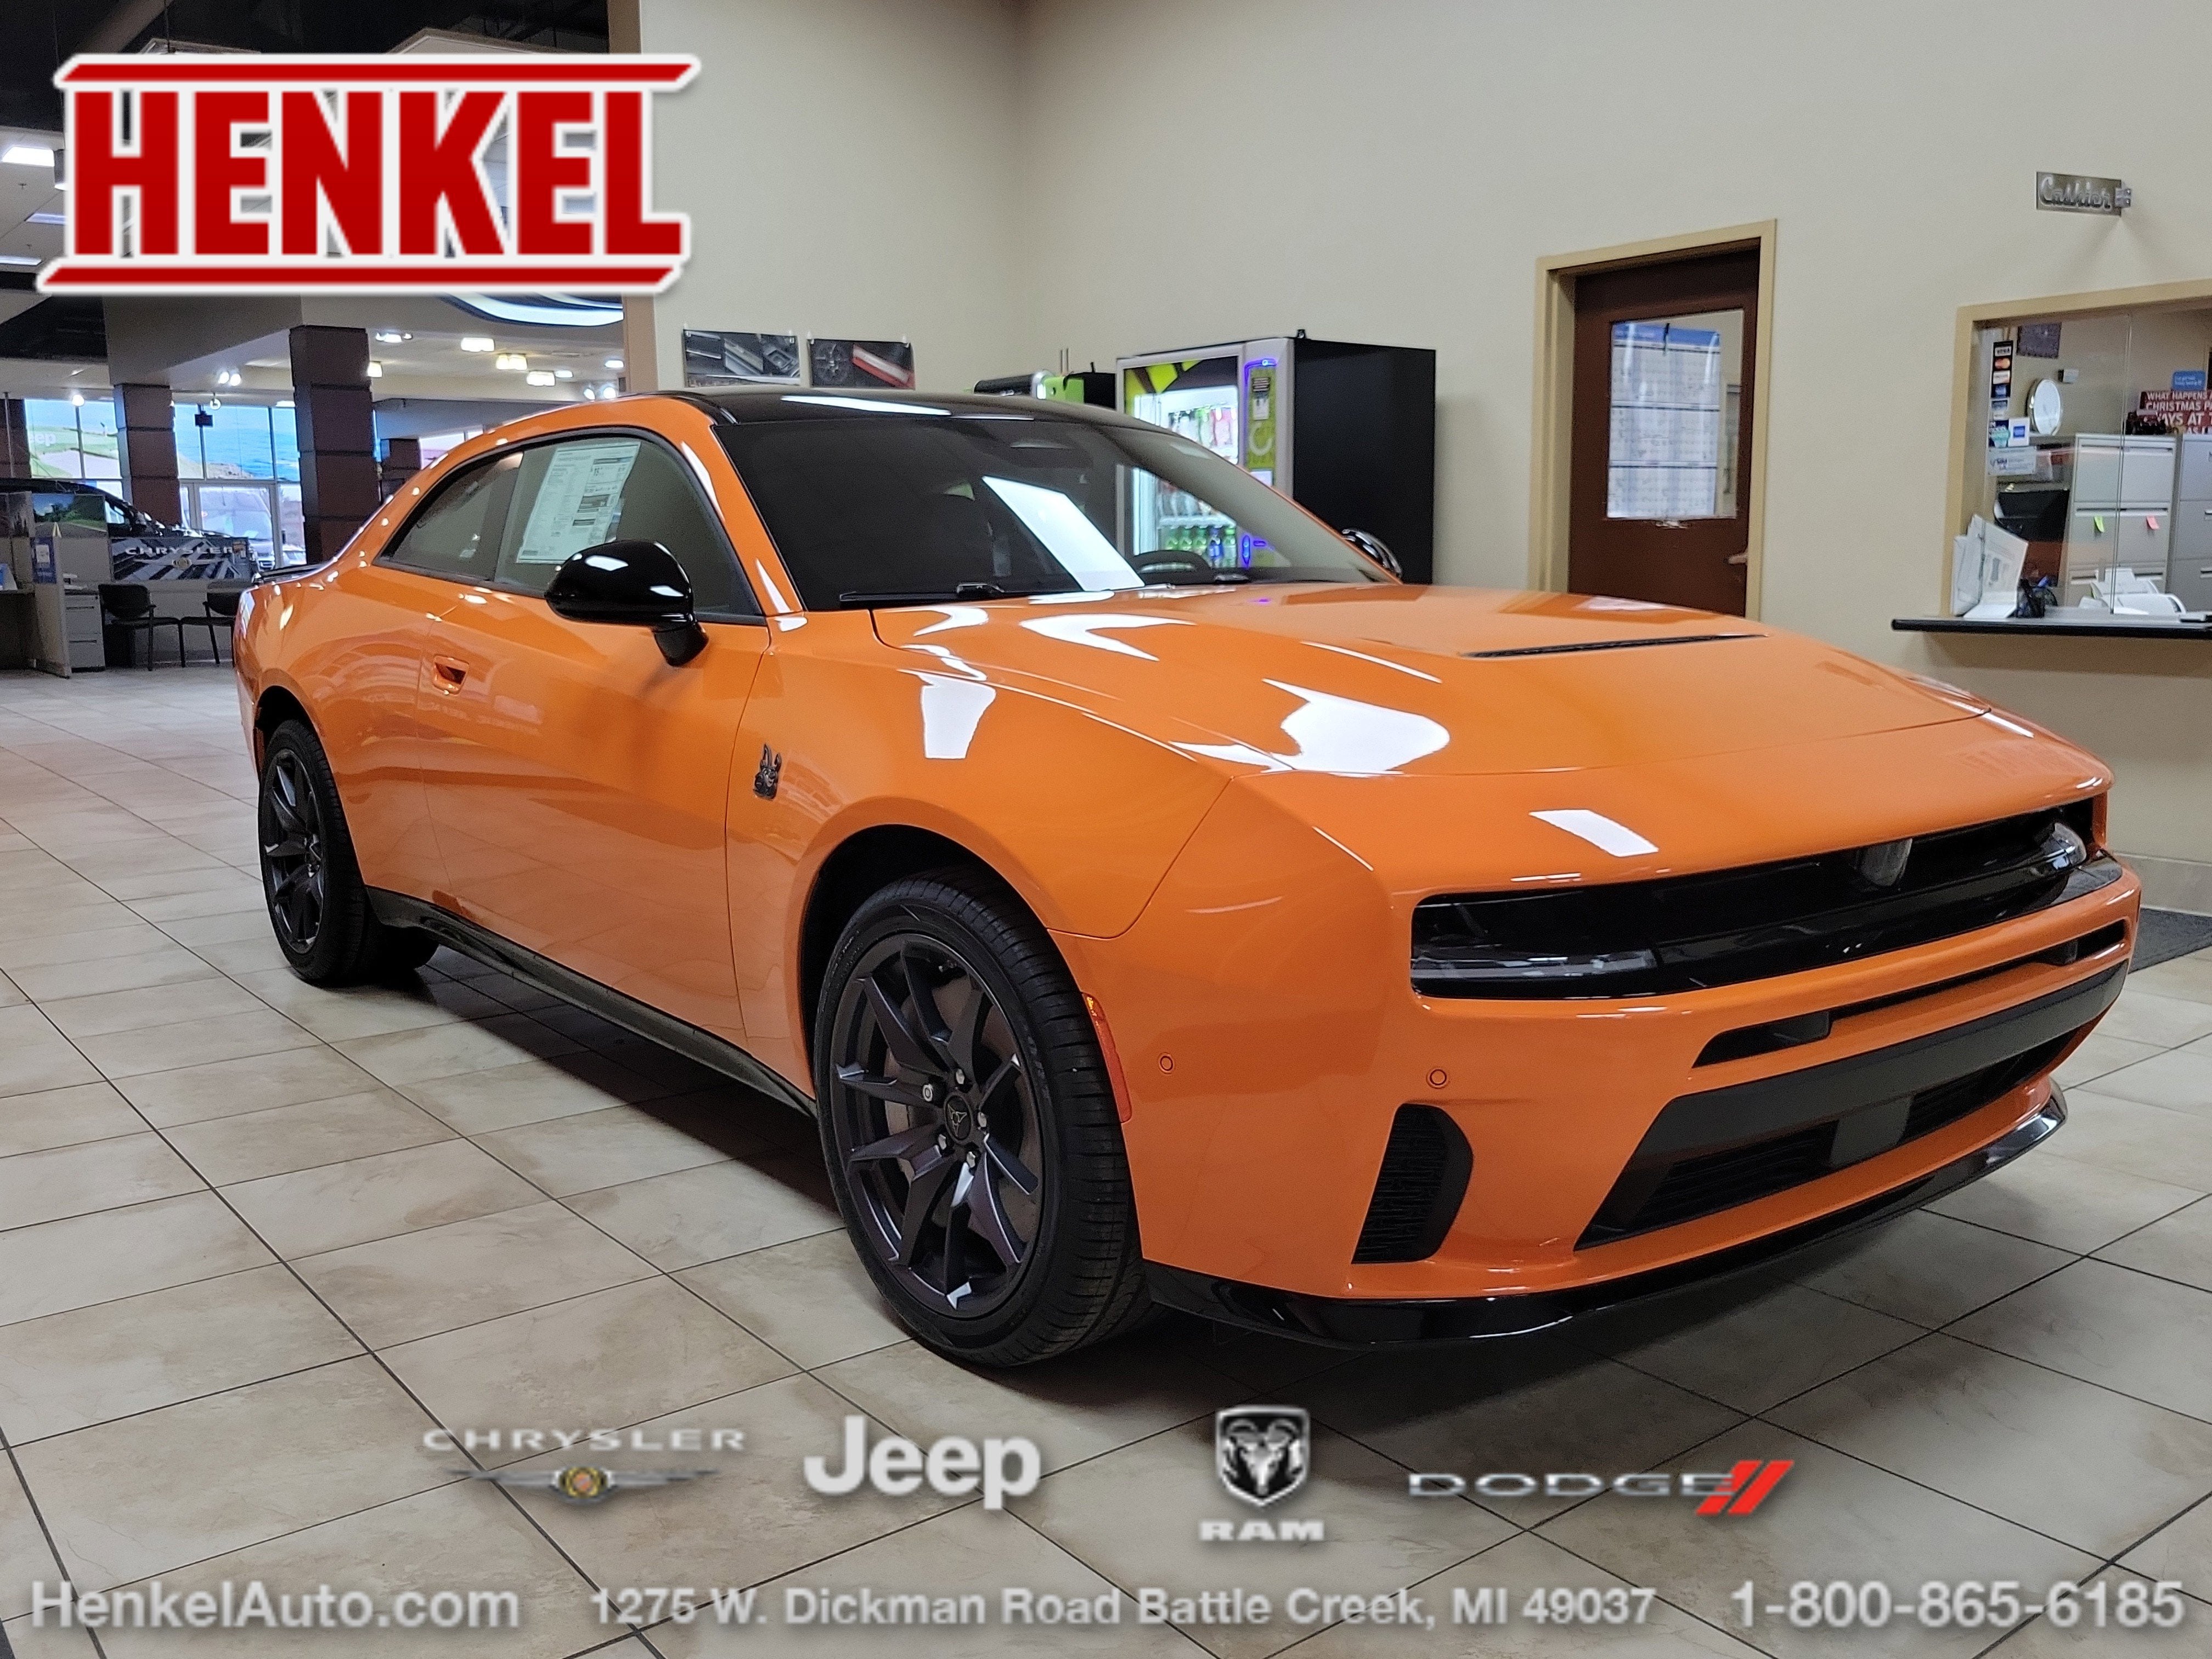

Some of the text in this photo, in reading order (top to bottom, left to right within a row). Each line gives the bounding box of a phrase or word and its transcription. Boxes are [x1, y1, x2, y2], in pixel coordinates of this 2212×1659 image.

[2039, 174, 2111, 211] Cashier
[2147, 391, 2170, 400] WHAT
[2172, 391, 2207, 400] HAPPENS
[2146, 400, 2201, 411] CHRISTMAS
[2187, 412, 2204, 426] AT
[27, 432, 57, 447] eep
[125, 547, 233, 555] CHRYSLER
